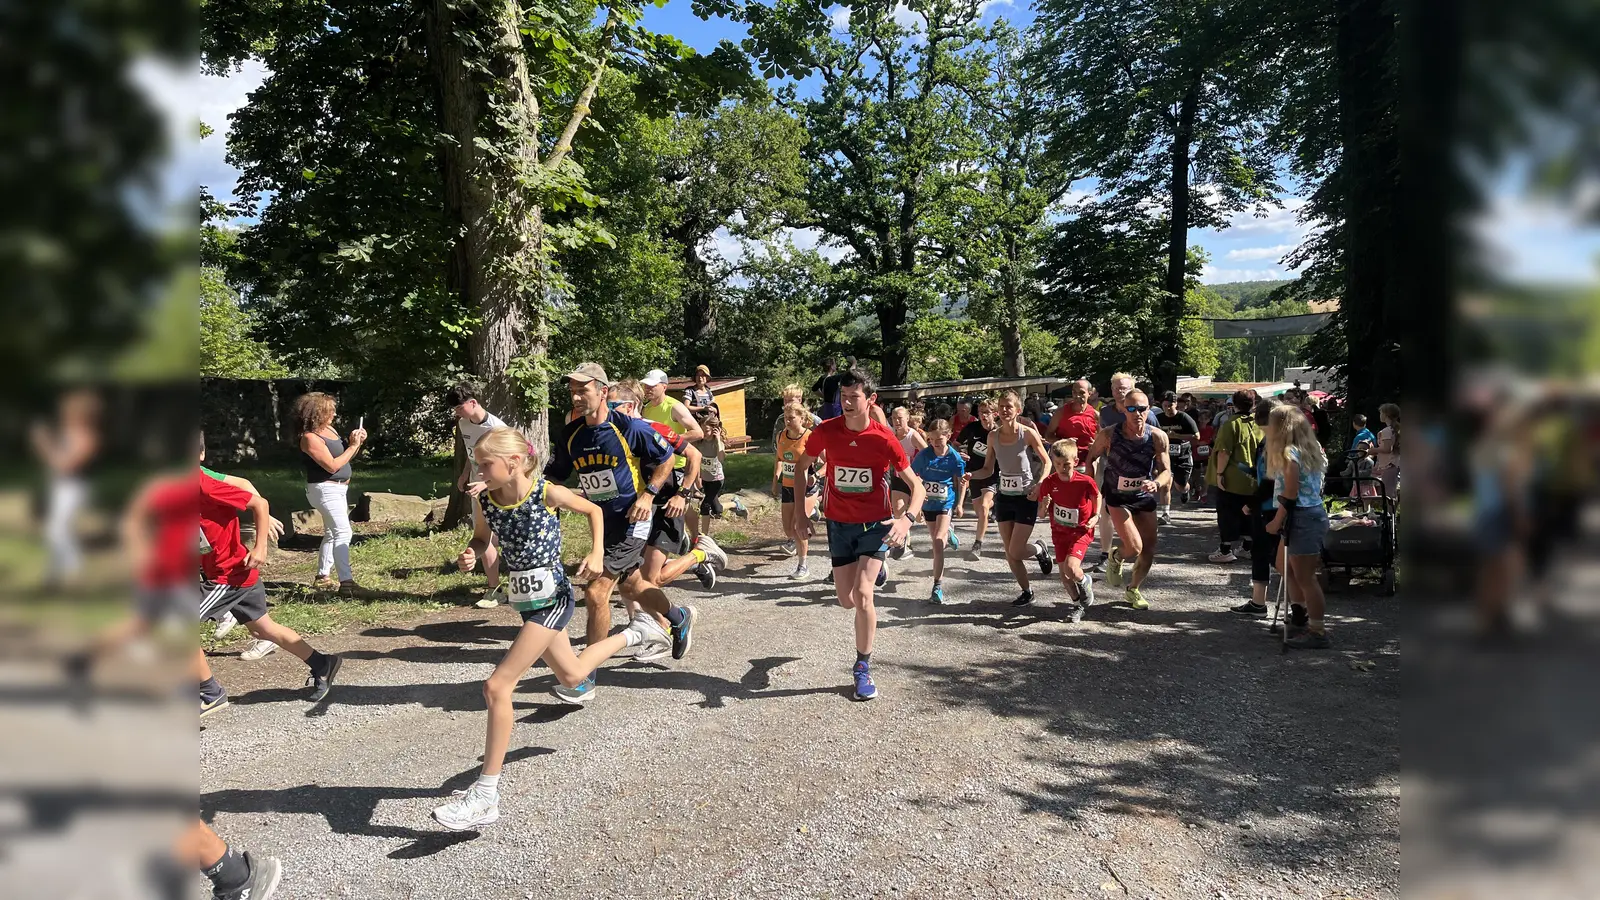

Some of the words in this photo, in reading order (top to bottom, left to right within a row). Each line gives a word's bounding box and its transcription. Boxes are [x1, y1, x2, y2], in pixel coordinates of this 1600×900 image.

[837, 468, 870, 483] 276
[1002, 478, 1018, 488] 373
[1123, 480, 1142, 488] 349
[1055, 507, 1072, 520] 361
[510, 575, 543, 595] 385
